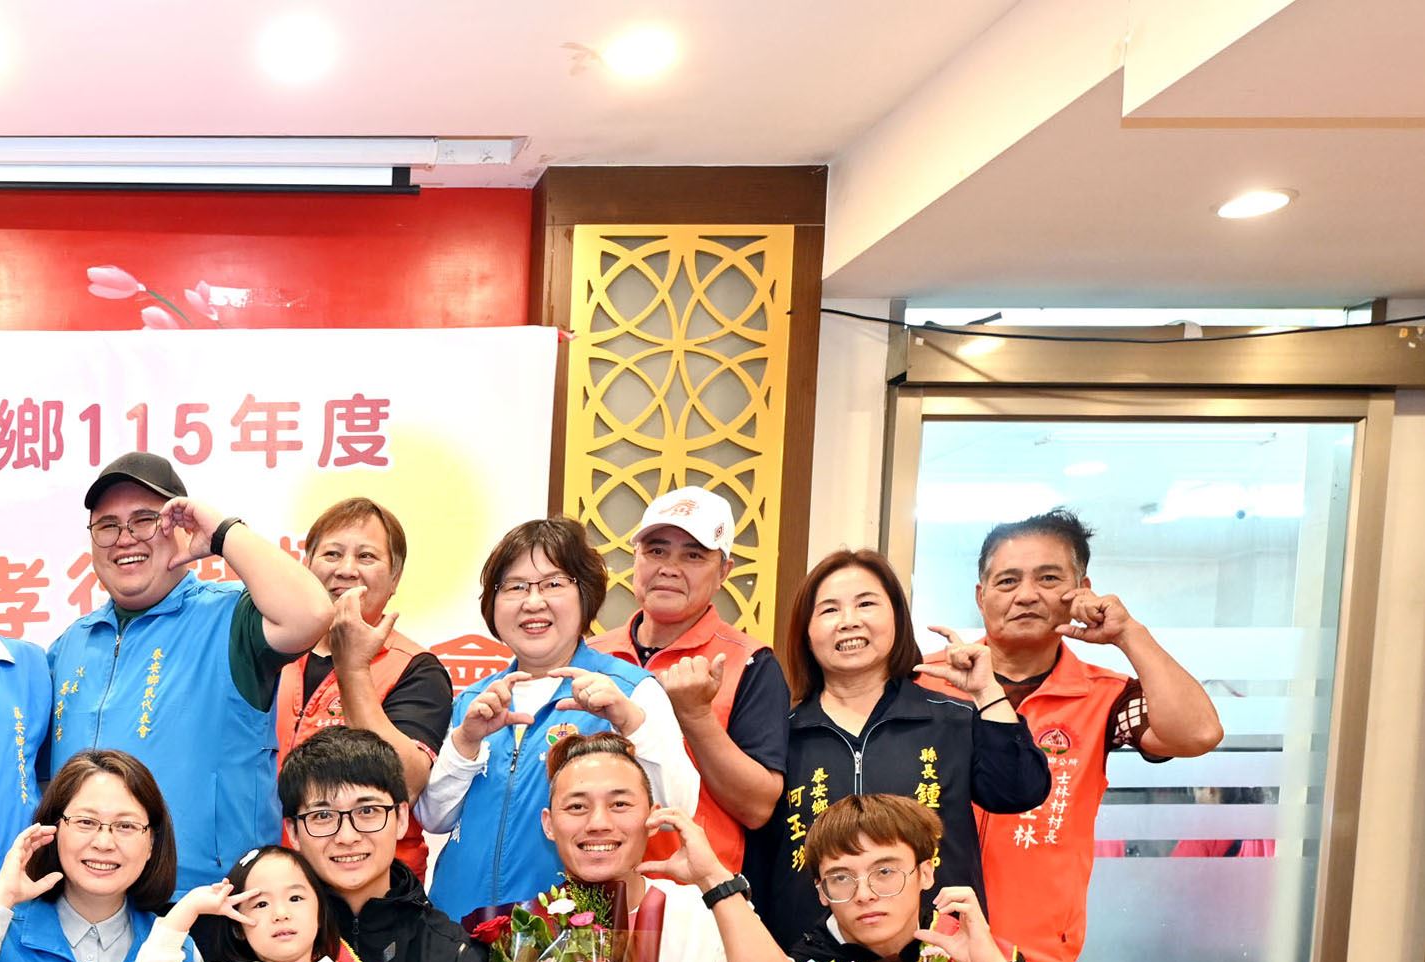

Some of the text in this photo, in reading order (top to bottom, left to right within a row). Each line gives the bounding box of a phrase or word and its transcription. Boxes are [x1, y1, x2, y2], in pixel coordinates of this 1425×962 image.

[1043, 770, 1072, 844] 士林村村長
